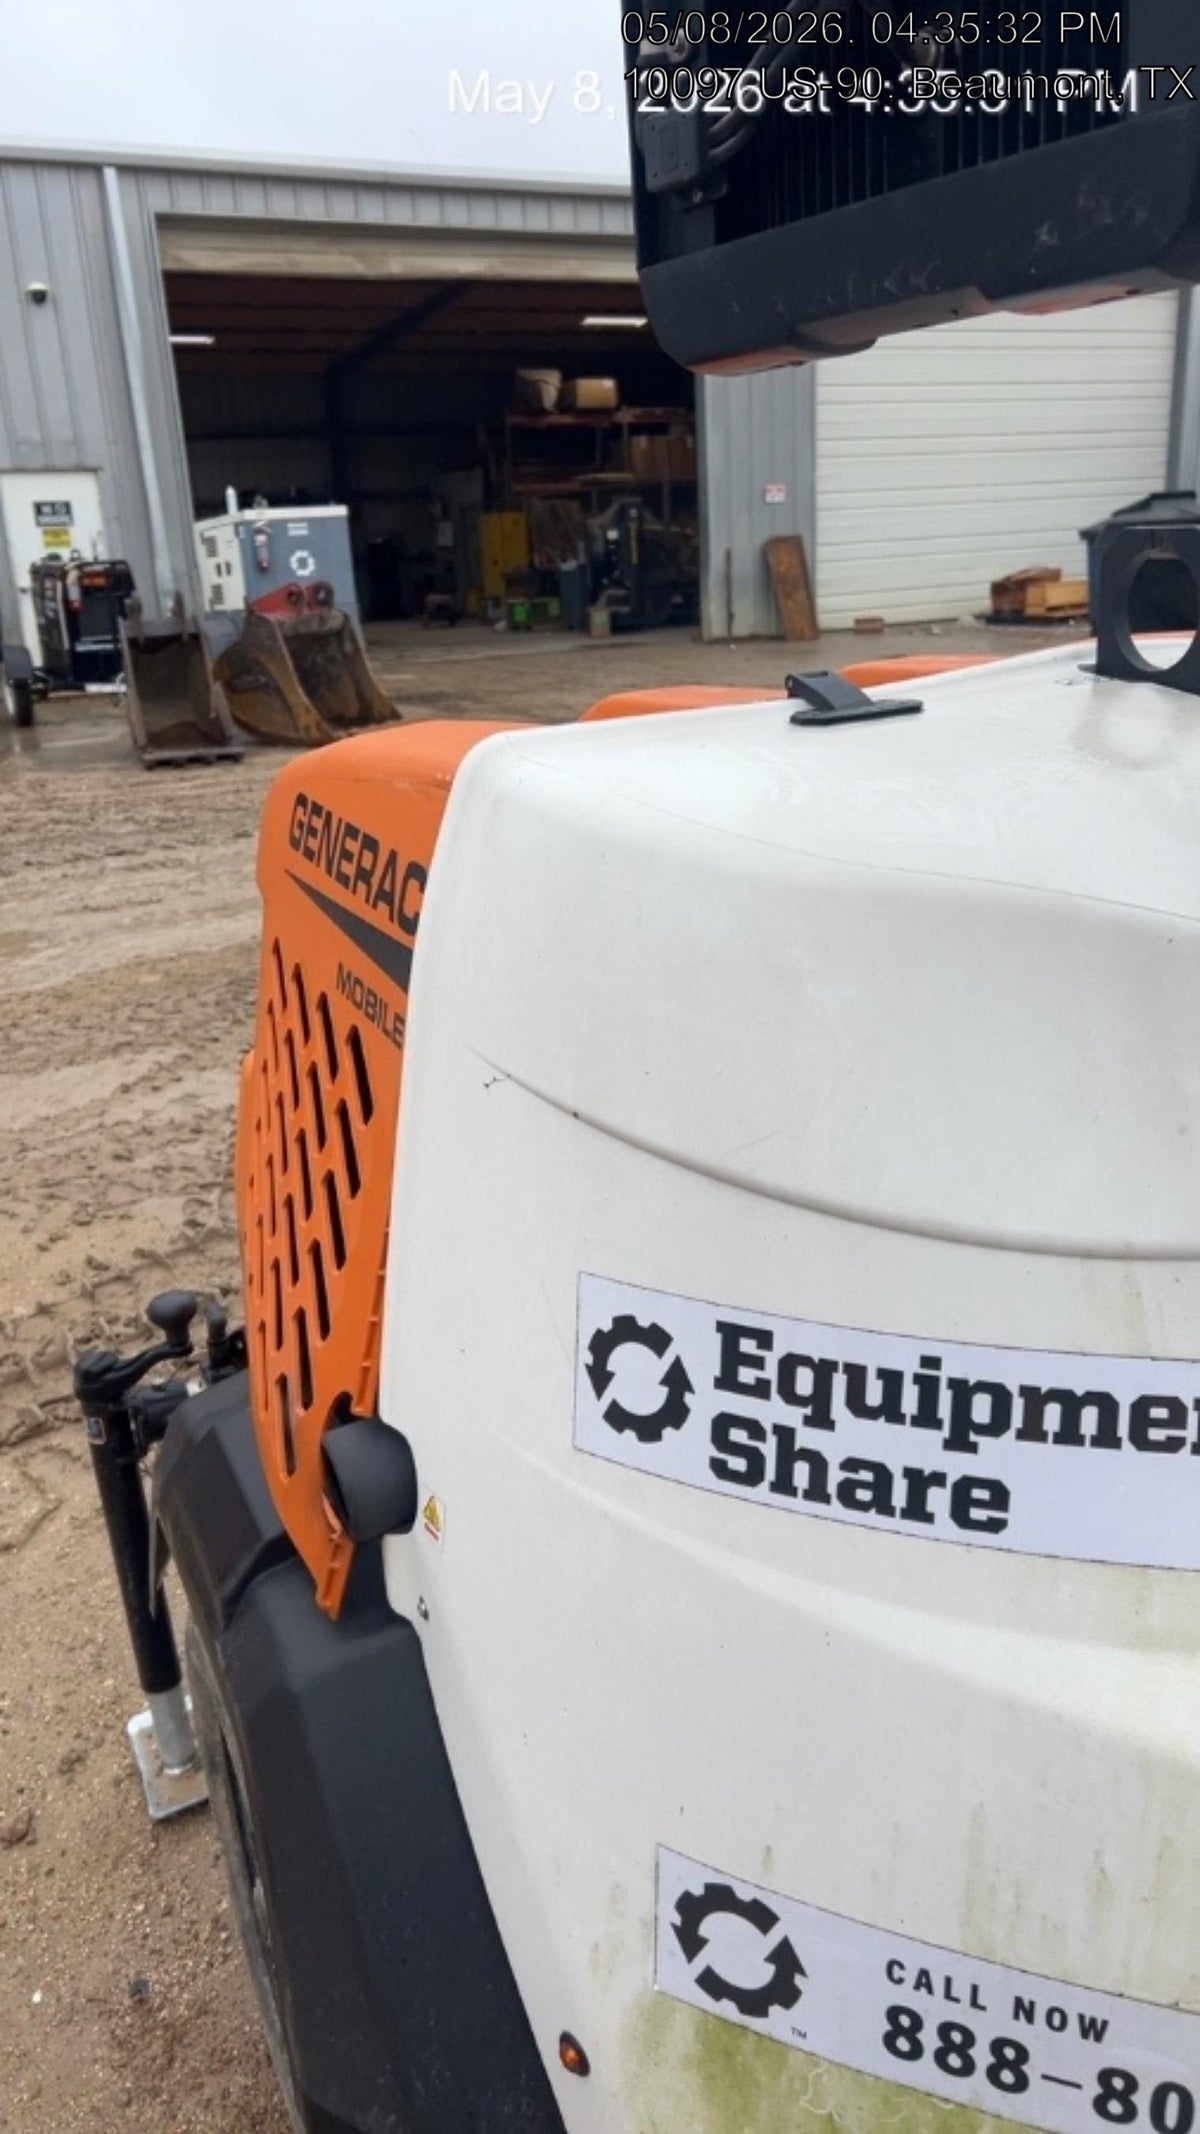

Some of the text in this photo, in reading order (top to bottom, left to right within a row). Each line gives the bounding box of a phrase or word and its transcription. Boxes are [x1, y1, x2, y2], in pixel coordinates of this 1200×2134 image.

[289, 792, 428, 936] GENERAC
[336, 961, 406, 1051] MOBILE
[714, 1320, 1200, 1455] Equipme
[709, 1411, 1010, 1534] Share
[885, 1959, 1110, 2043] CALL NOW
